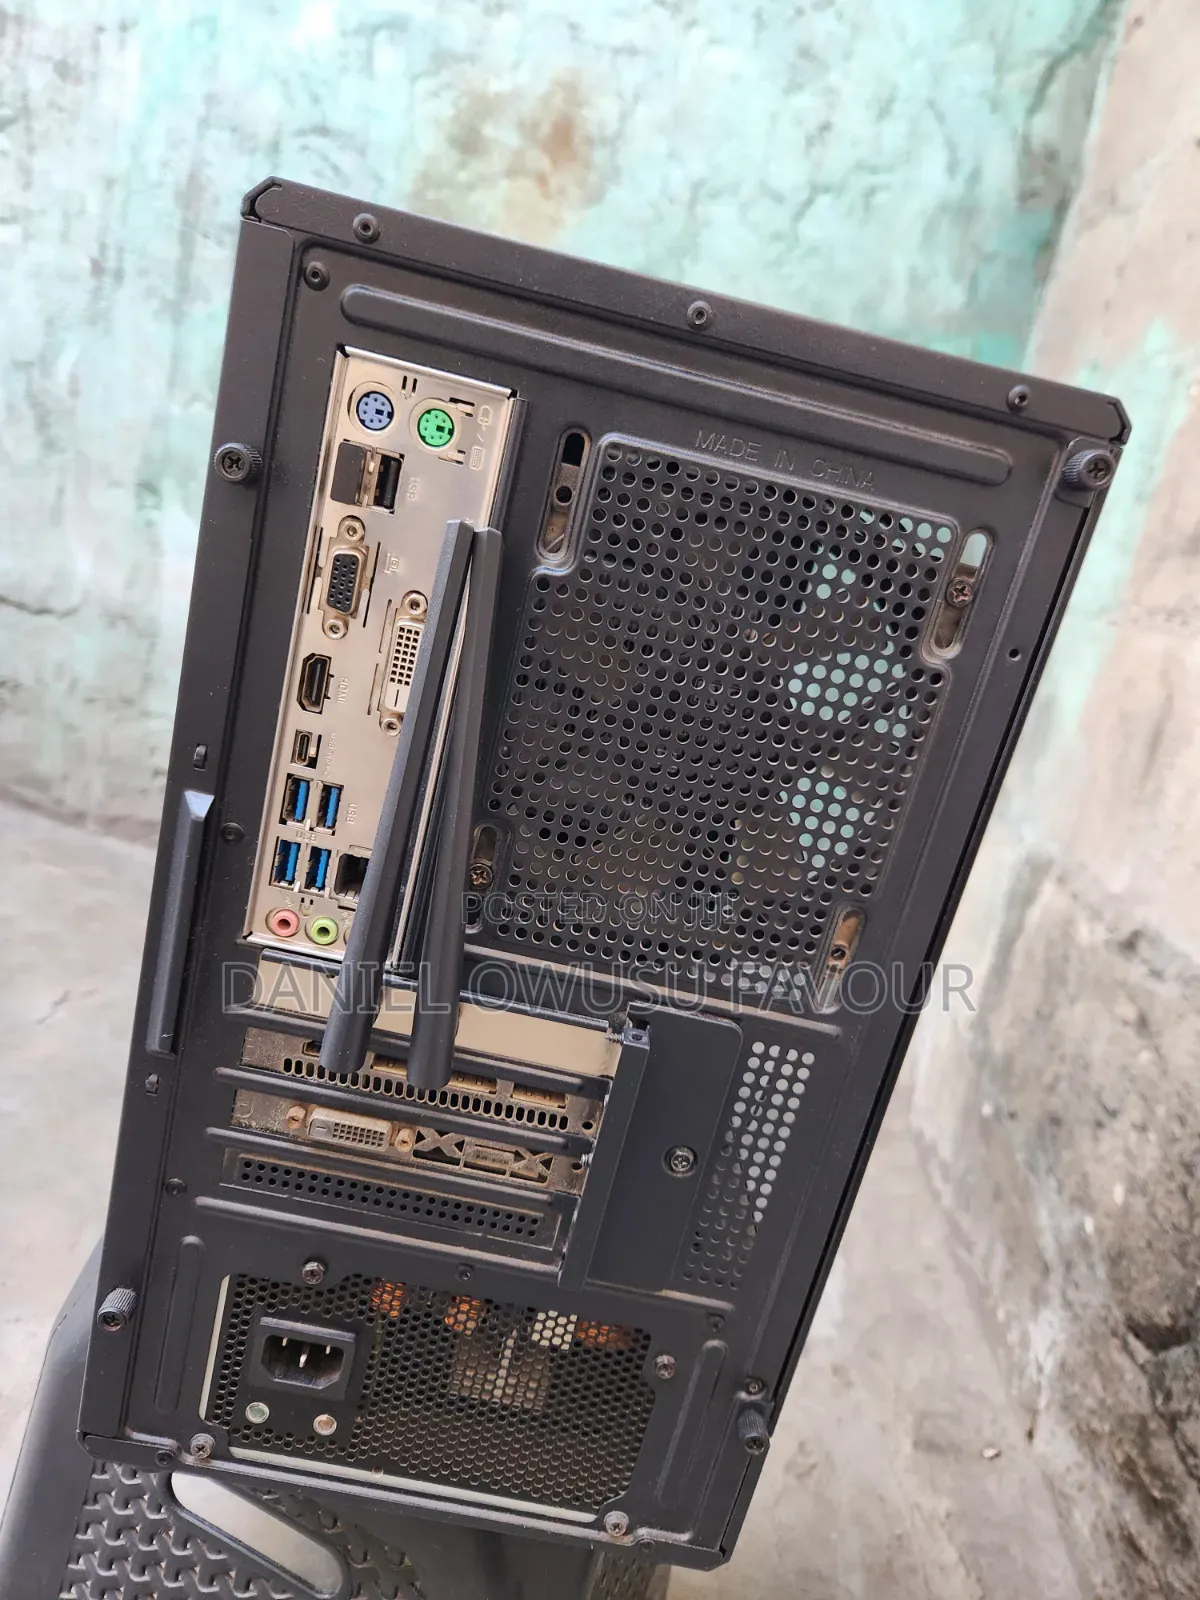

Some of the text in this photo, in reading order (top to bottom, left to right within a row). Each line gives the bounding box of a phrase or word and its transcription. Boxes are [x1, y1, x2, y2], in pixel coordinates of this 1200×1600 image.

[695, 431, 875, 491] MADE IN CHINA
[337, 677, 349, 704] HDMI
[346, 802, 359, 825] USB
[295, 830, 317, 843] USB
